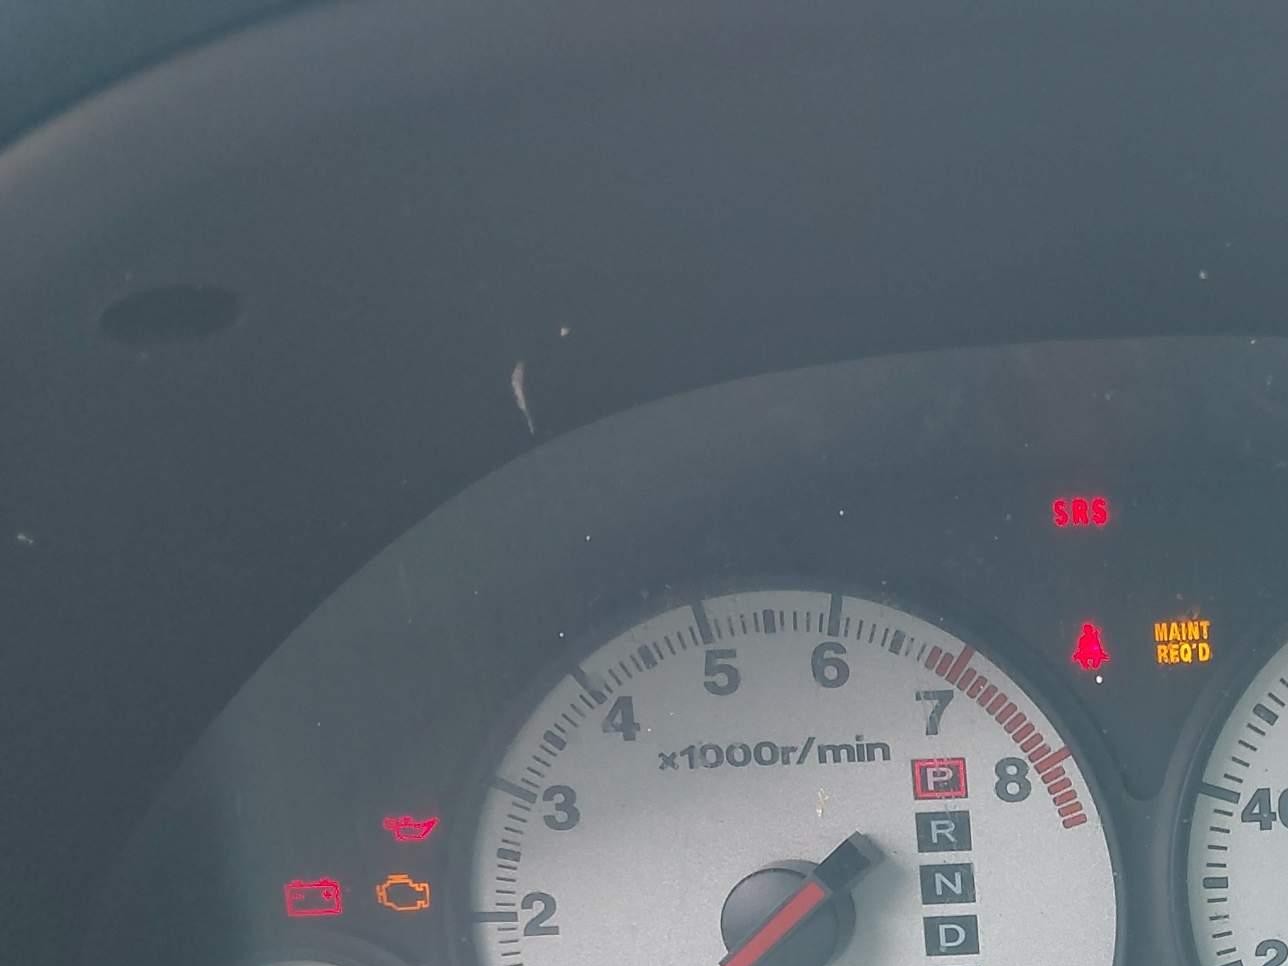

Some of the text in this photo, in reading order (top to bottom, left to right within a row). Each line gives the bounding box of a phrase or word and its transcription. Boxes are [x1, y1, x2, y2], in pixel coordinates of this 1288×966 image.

[1053, 499, 1108, 527] SRS
[1154, 620, 1210, 642] MAINT
[811, 641, 850, 689] 6
[1157, 642, 1211, 664] REQ'D
[703, 648, 741, 696] 5
[602, 695, 640, 741] 4
[915, 689, 954, 736] 7
[925, 767, 954, 791] P
[994, 756, 1032, 803] 8
[542, 784, 581, 831] 3
[930, 819, 957, 844] R
[934, 871, 963, 895] N
[520, 891, 561, 937] 2
[938, 923, 966, 948] D
